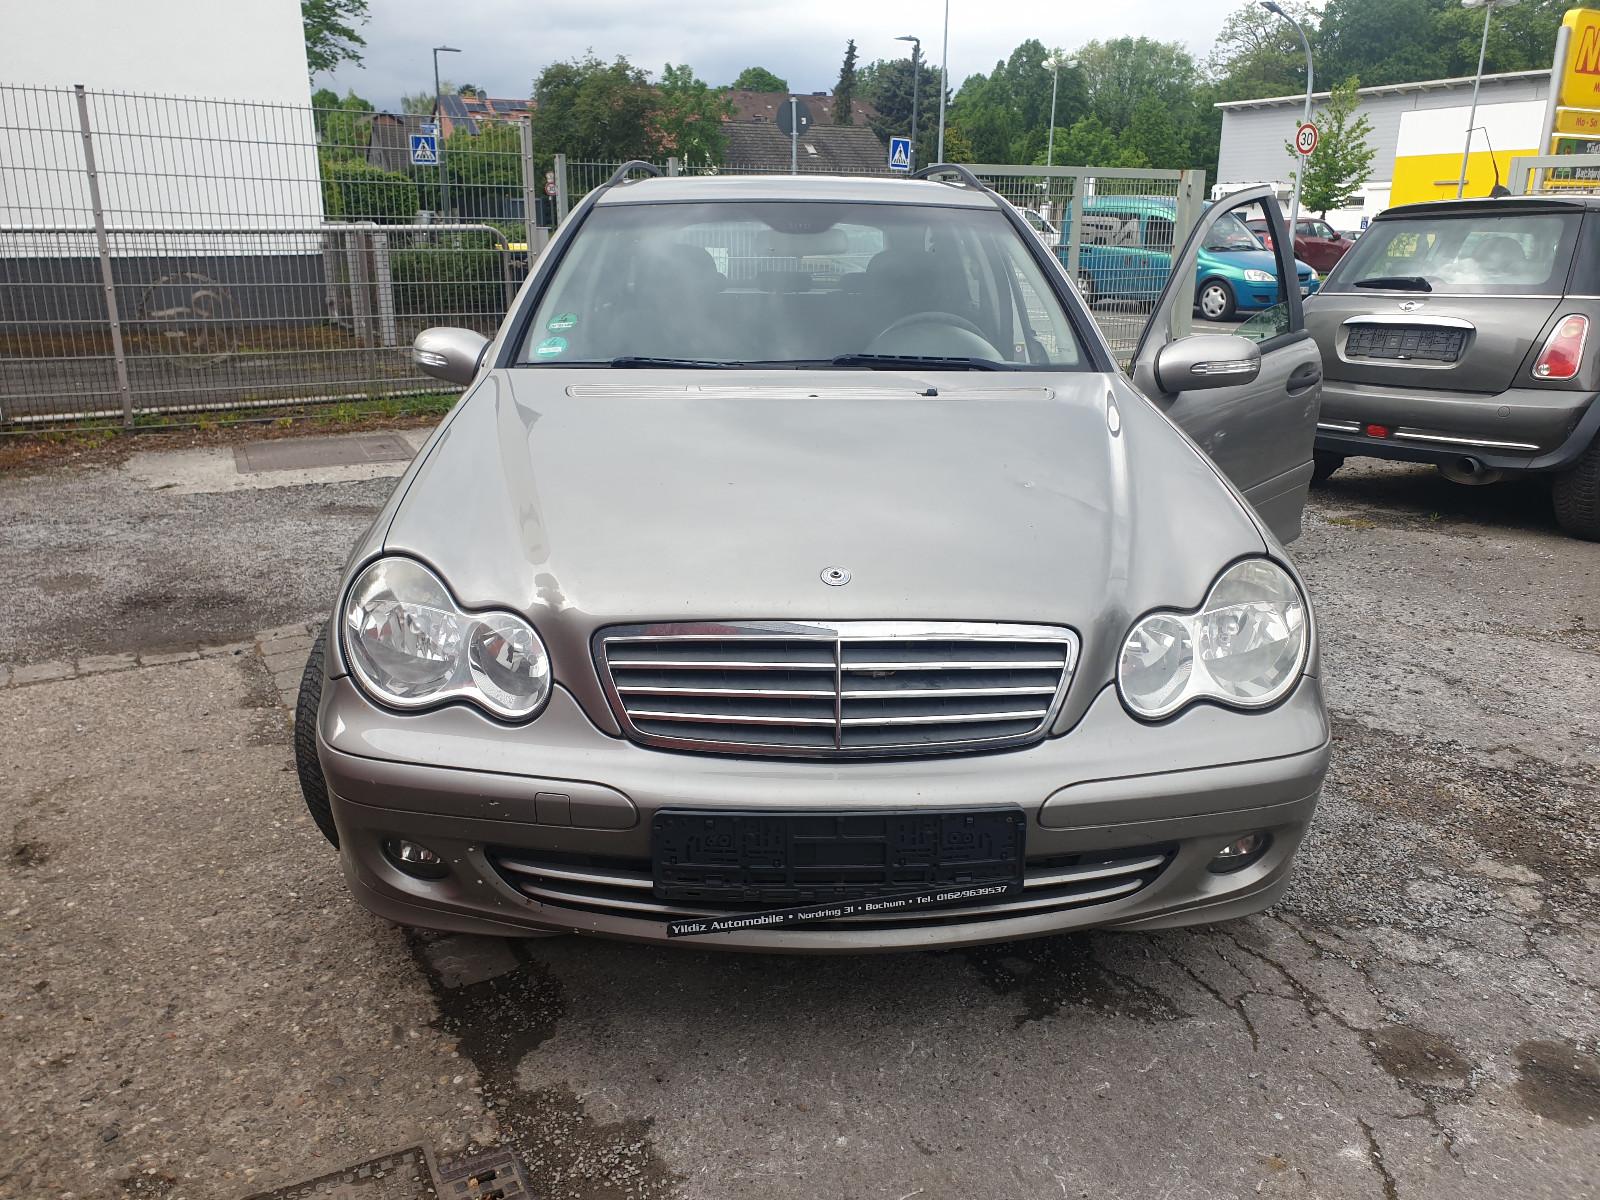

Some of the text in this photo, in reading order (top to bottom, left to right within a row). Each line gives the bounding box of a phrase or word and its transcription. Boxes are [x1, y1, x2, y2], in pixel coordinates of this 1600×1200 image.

[1300, 132, 1313, 146] 30
[710, 914, 784, 930] Automobile
[797, 909, 841, 920] Nordring
[843, 906, 854, 914] 31
[865, 900, 906, 911] Bochum
[916, 895, 934, 904] Tel.
[936, 885, 1008, 901] 0162/9639537
